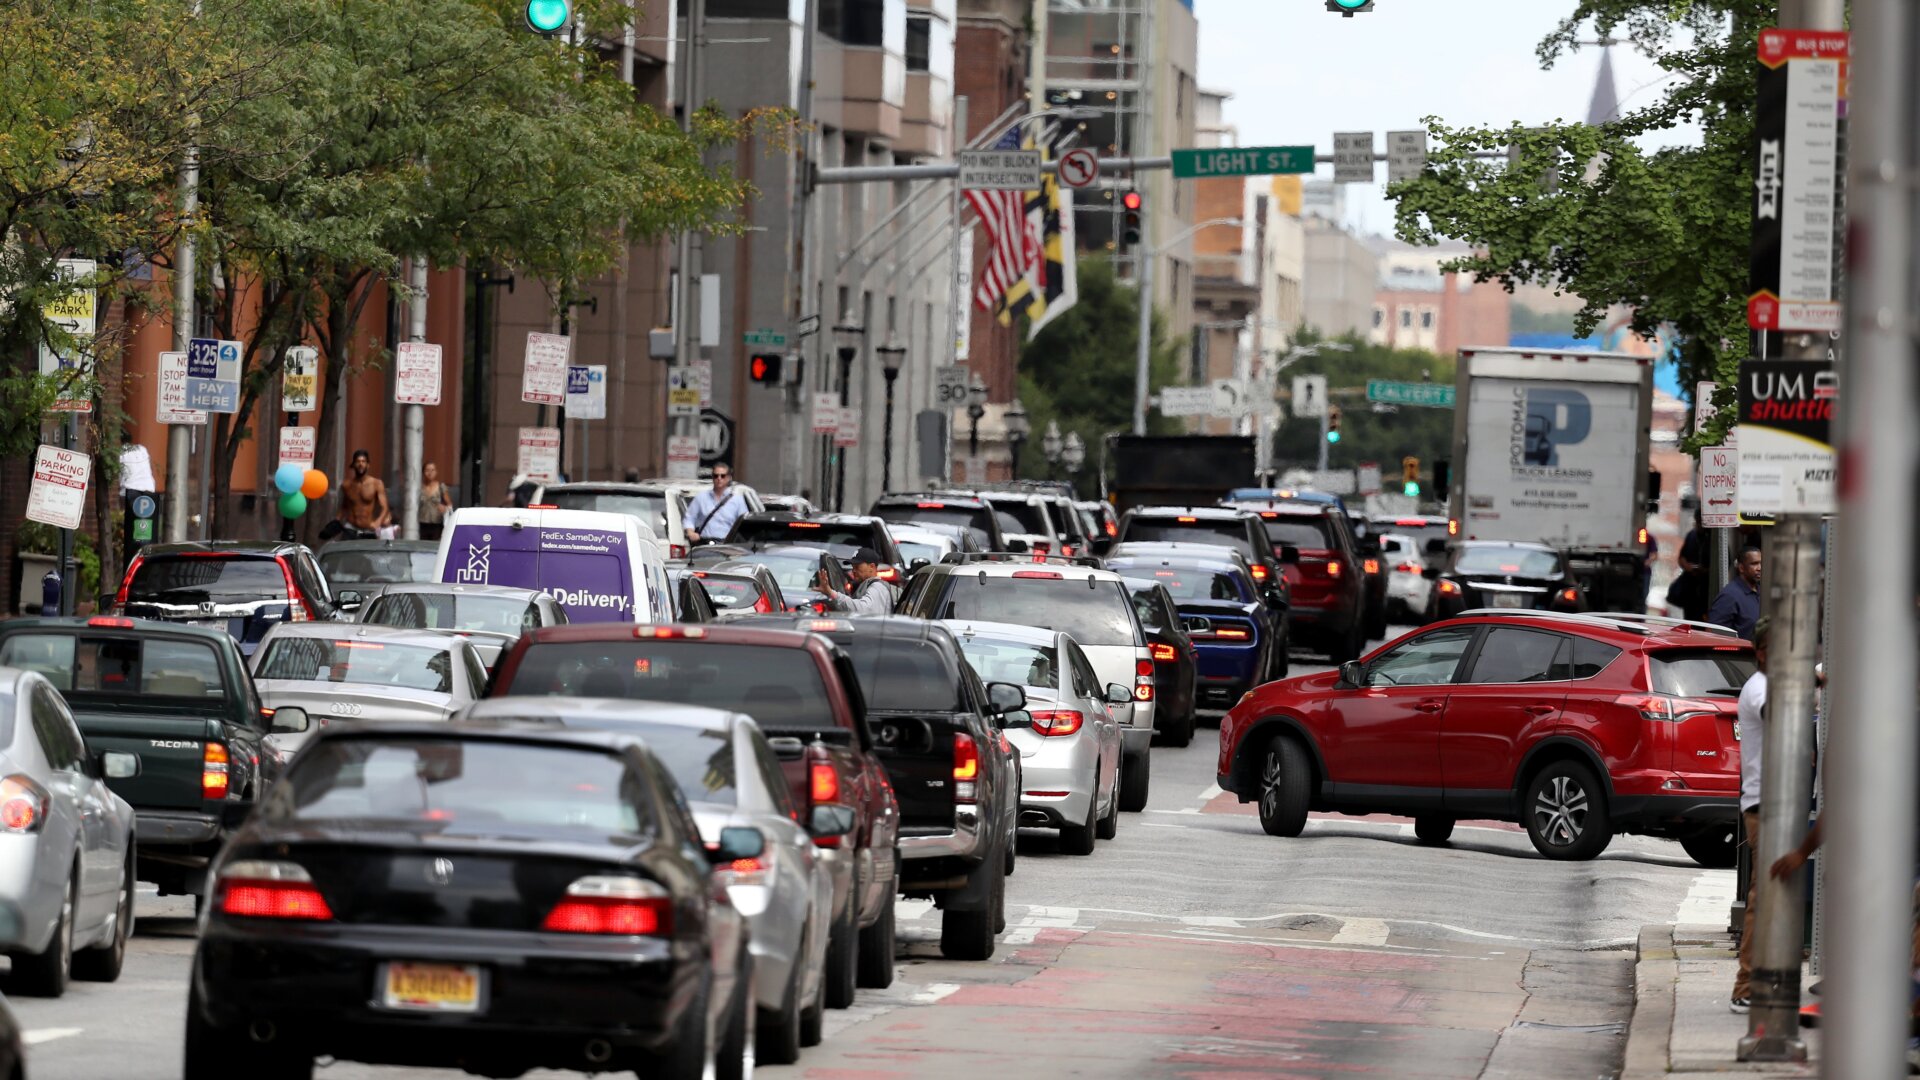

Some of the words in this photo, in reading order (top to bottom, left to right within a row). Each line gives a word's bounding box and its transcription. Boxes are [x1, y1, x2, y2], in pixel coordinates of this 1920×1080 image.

[1796, 38, 1817, 50] BUS
[1819, 38, 1845, 51] STOP
[981, 155, 1000, 168] NOT
[1003, 155, 1037, 168] BLOCK
[1195, 152, 1260, 173] LIGHT
[1267, 152, 1297, 169] ST.
[1335, 154, 1370, 165] BLOCK
[966, 172, 1035, 184] INTERSECTION
[1761, 153, 1775, 206] LINK
[73, 295, 87, 305] TO
[54, 306, 82, 316] PARK
[1789, 309, 1801, 318] NO
[223, 346, 234, 357] 4
[200, 366, 215, 374] hour
[198, 382, 225, 394] PAY
[938, 384, 965, 401] 30
[192, 396, 229, 406] HERE
[1510, 386, 1524, 466] POTOMAC
[283, 439, 311, 447] PARKING
[57, 452, 72, 462] NO
[1713, 454, 1726, 467] NO
[41, 459, 84, 476] PARKING
[37, 473, 51, 481] TOW
[1548, 468, 1593, 479] LEASING
[1704, 475, 1736, 488] STOPPING
[541, 531, 565, 541] FedEx
[606, 535, 622, 545] City
[541, 542, 610, 552] fedex.com/samedaycity
[553, 587, 630, 612] Delivery.
[151, 740, 200, 750] TACOMA
